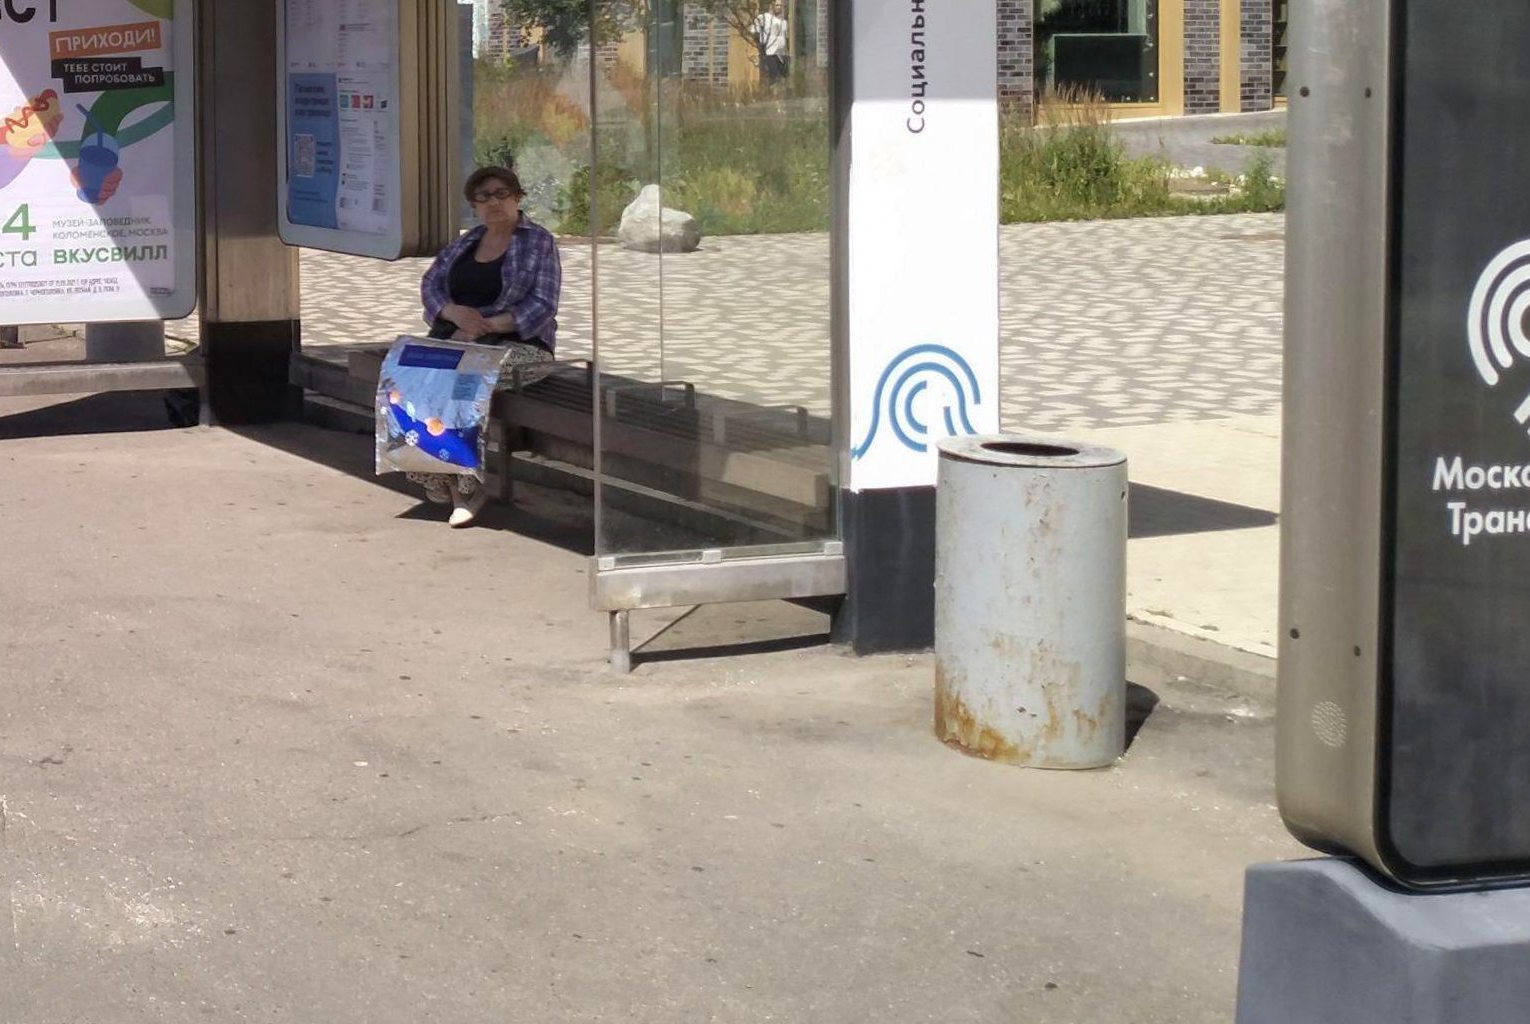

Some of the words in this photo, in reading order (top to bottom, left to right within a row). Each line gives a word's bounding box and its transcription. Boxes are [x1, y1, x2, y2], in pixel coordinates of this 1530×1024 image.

[55, 28, 156, 53] ПРИХОДИ!
[63, 63, 89, 73] ТЕБЕ
[91, 62, 128, 72] СТОИТ
[74, 72, 156, 84] ПОПРОБОВАТЬ
[53, 245, 168, 264] ВКУСВИЛЛ
[1446, 502, 1530, 546] Тран
